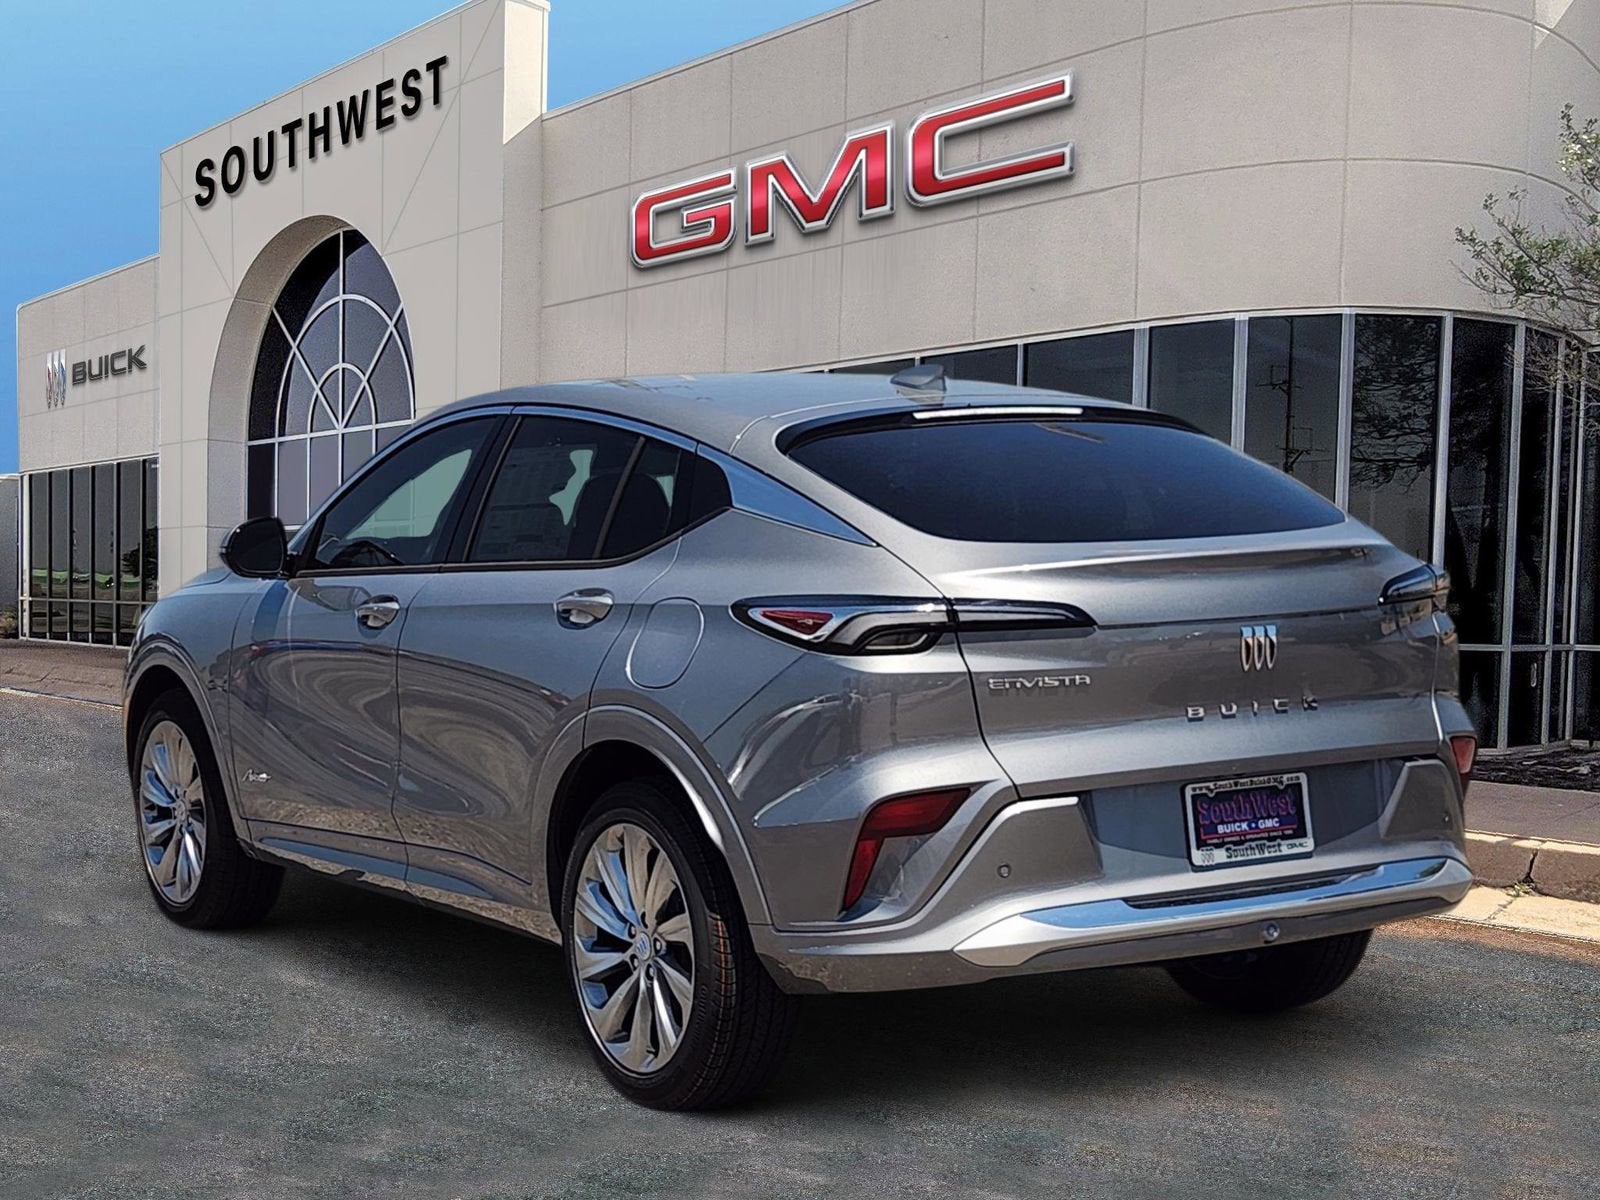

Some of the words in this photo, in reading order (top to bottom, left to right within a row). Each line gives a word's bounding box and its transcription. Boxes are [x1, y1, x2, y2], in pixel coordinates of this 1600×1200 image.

[195, 55, 448, 207] SOUTHWEST
[630, 70, 1076, 269] GMC
[72, 344, 147, 386] BUICK
[988, 674, 1091, 689] ENVISTA
[1186, 696, 1319, 721] BUICK
[1217, 821, 1250, 834] BUICK
[1258, 818, 1280, 828] GMC
